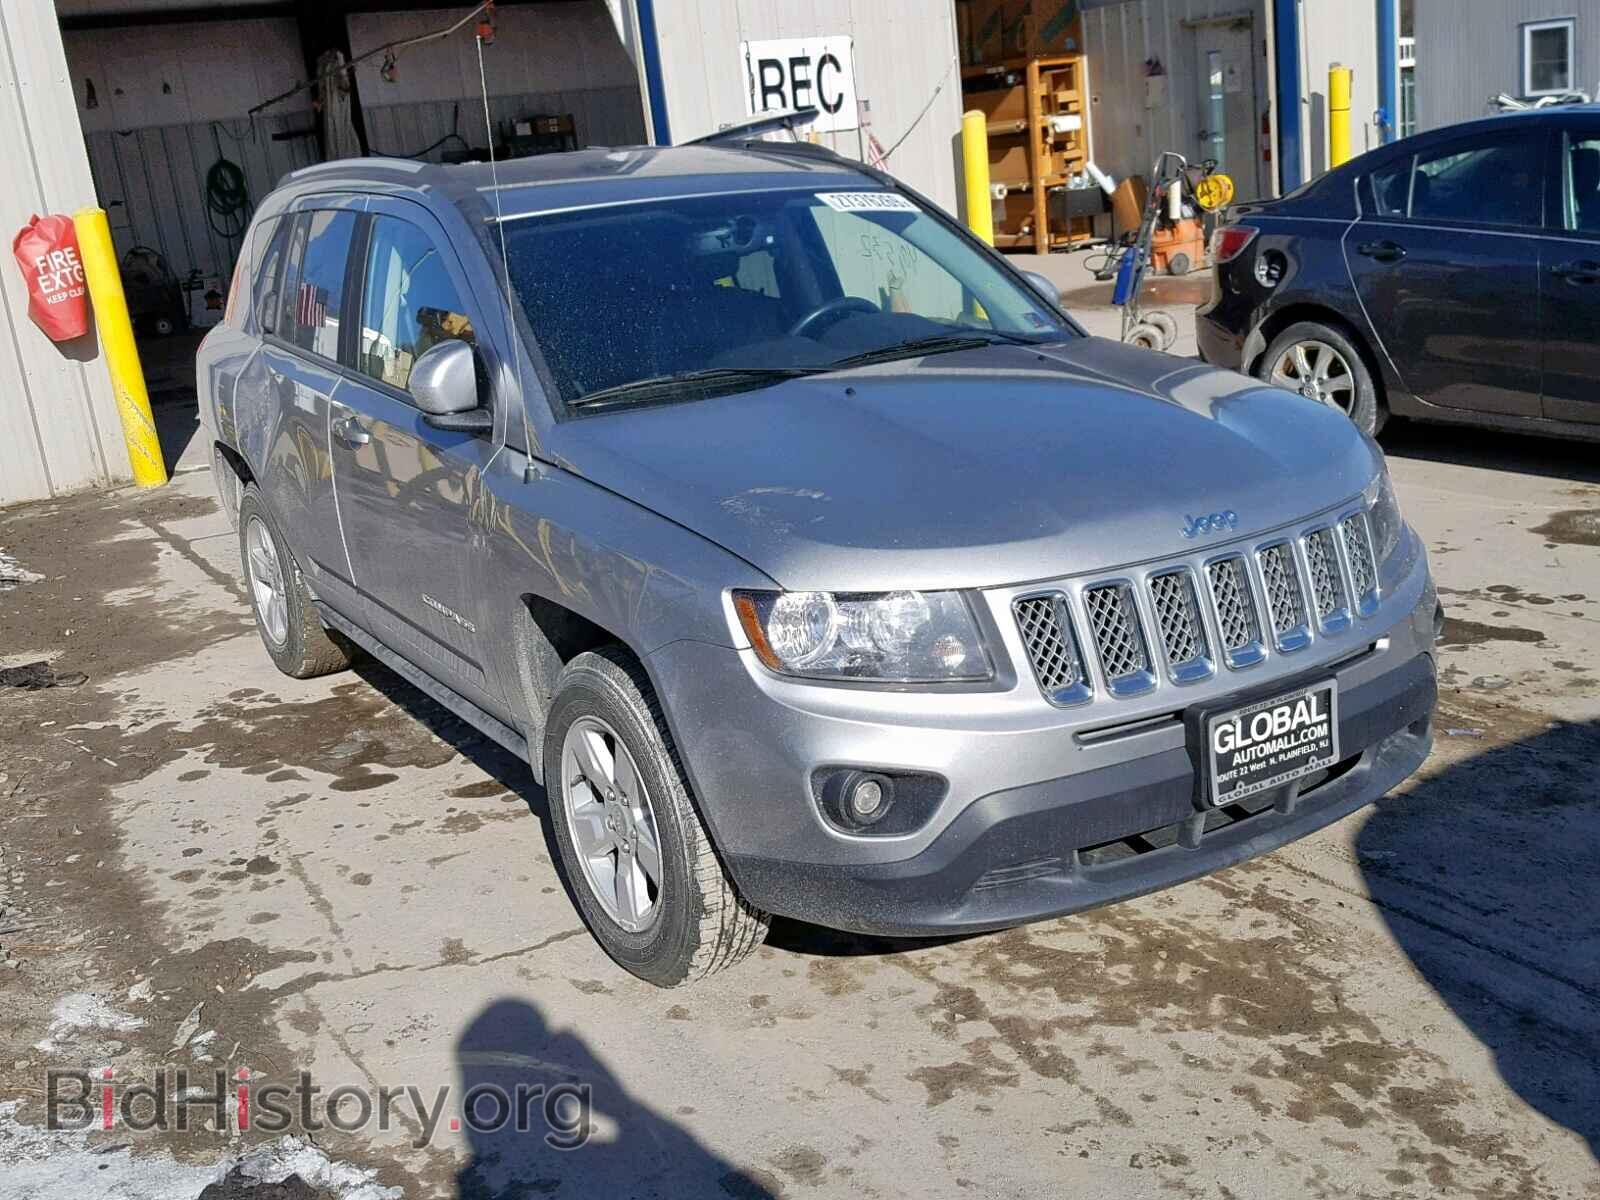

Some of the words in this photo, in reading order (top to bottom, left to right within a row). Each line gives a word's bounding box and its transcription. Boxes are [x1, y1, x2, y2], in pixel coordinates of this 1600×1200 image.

[757, 53, 844, 114] REC
[36, 247, 79, 275] FIRE
[47, 292, 68, 304] KEEP
[69, 286, 84, 298] CLE
[1183, 510, 1238, 538] Jeep
[1214, 695, 1328, 754] GLOBAL
[1232, 722, 1329, 767] AUTOMALL.COM
[1239, 766, 1249, 776] 22
[1319, 738, 1329, 748] NJ
[1218, 782, 1264, 803] GLOBAL
[1270, 769, 1300, 786] AUTO
[1303, 758, 1333, 773] MALL
